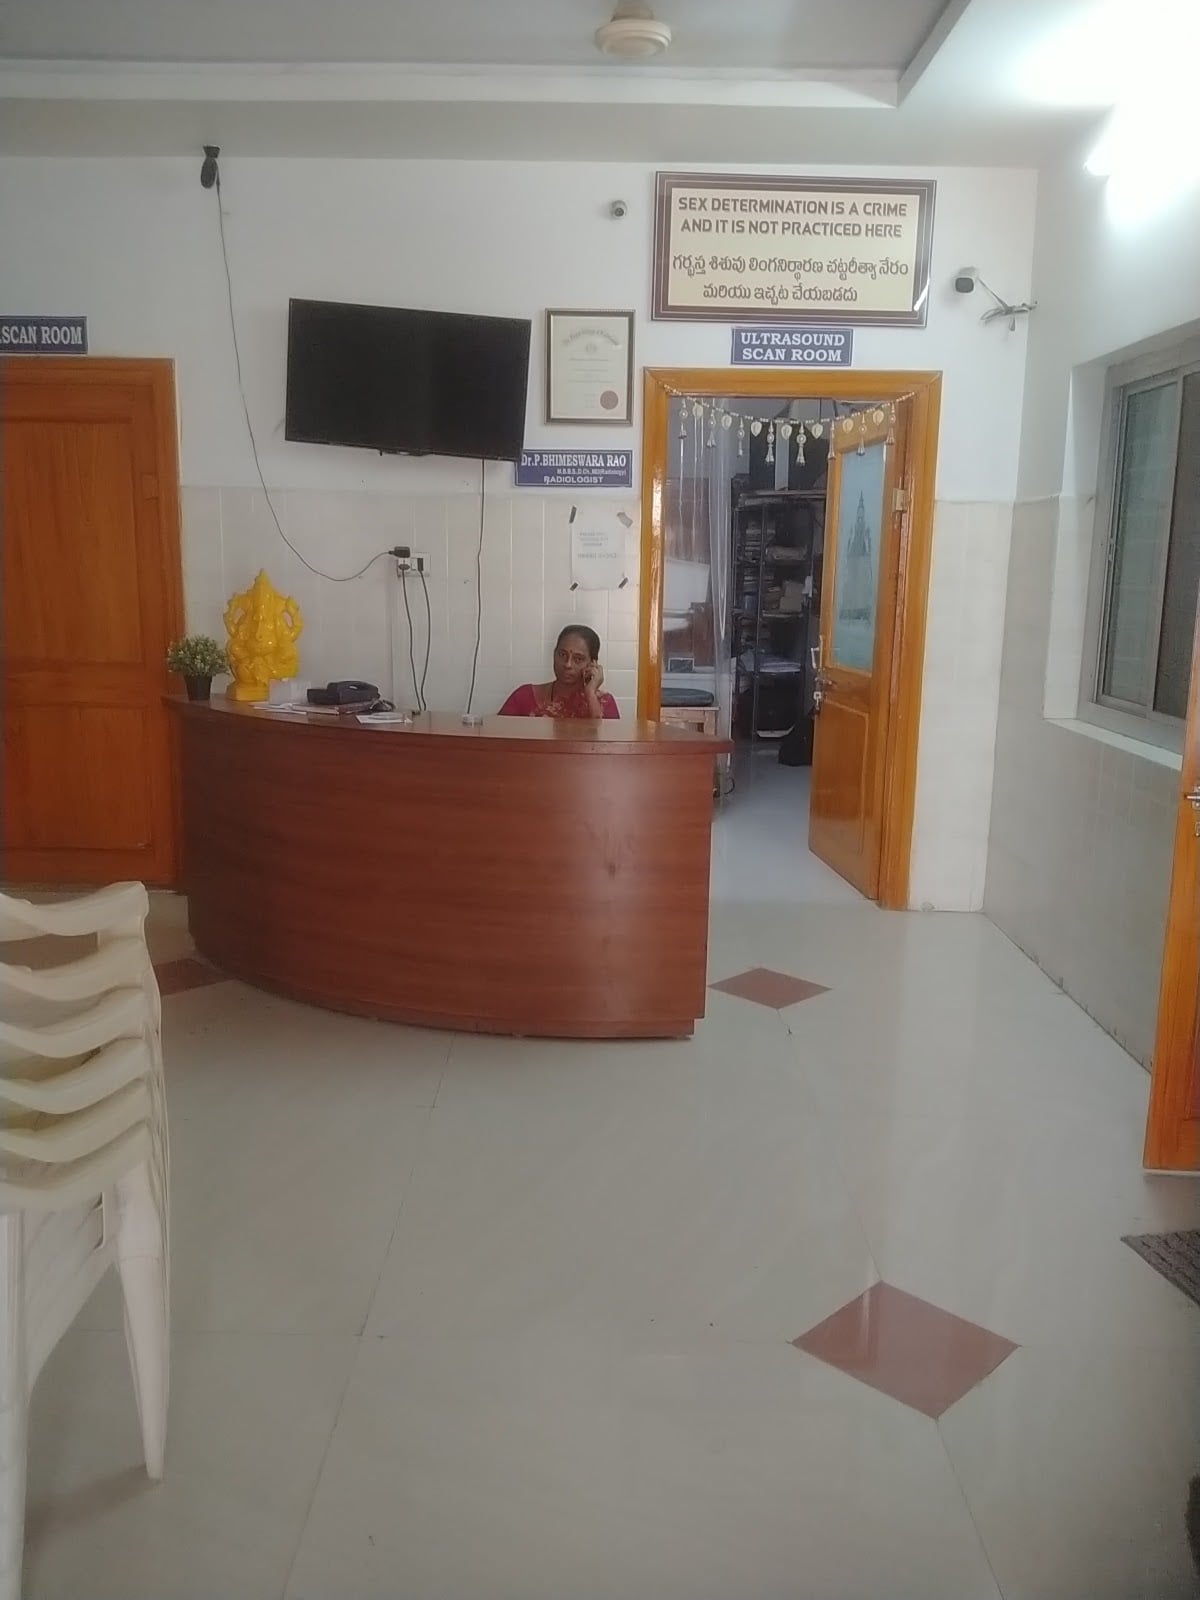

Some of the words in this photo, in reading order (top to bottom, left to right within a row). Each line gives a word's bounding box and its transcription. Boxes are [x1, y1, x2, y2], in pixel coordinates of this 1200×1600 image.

[678, 197, 708, 212] SEX
[711, 197, 828, 215] DETERMINATION
[831, 201, 845, 215] IS
[848, 202, 859, 216] A
[863, 202, 907, 217] CRIME
[681, 219, 712, 233] AND
[715, 219, 728, 234] IT
[732, 220, 745, 234] IS
[749, 220, 778, 235] NOT
[782, 222, 861, 237] PRACTICED
[865, 224, 902, 238] HERE
[879, 257, 909, 275] నేరం
[703, 283, 751, 299] మరియు
[41, 326, 83, 344] ROOM
[740, 332, 845, 347] ULTRASOUND
[742, 348, 787, 361] SCAN
[790, 349, 842, 362] ROOM
[606, 454, 626, 467] RAO
[543, 476, 604, 485] RADIOLOGIST
